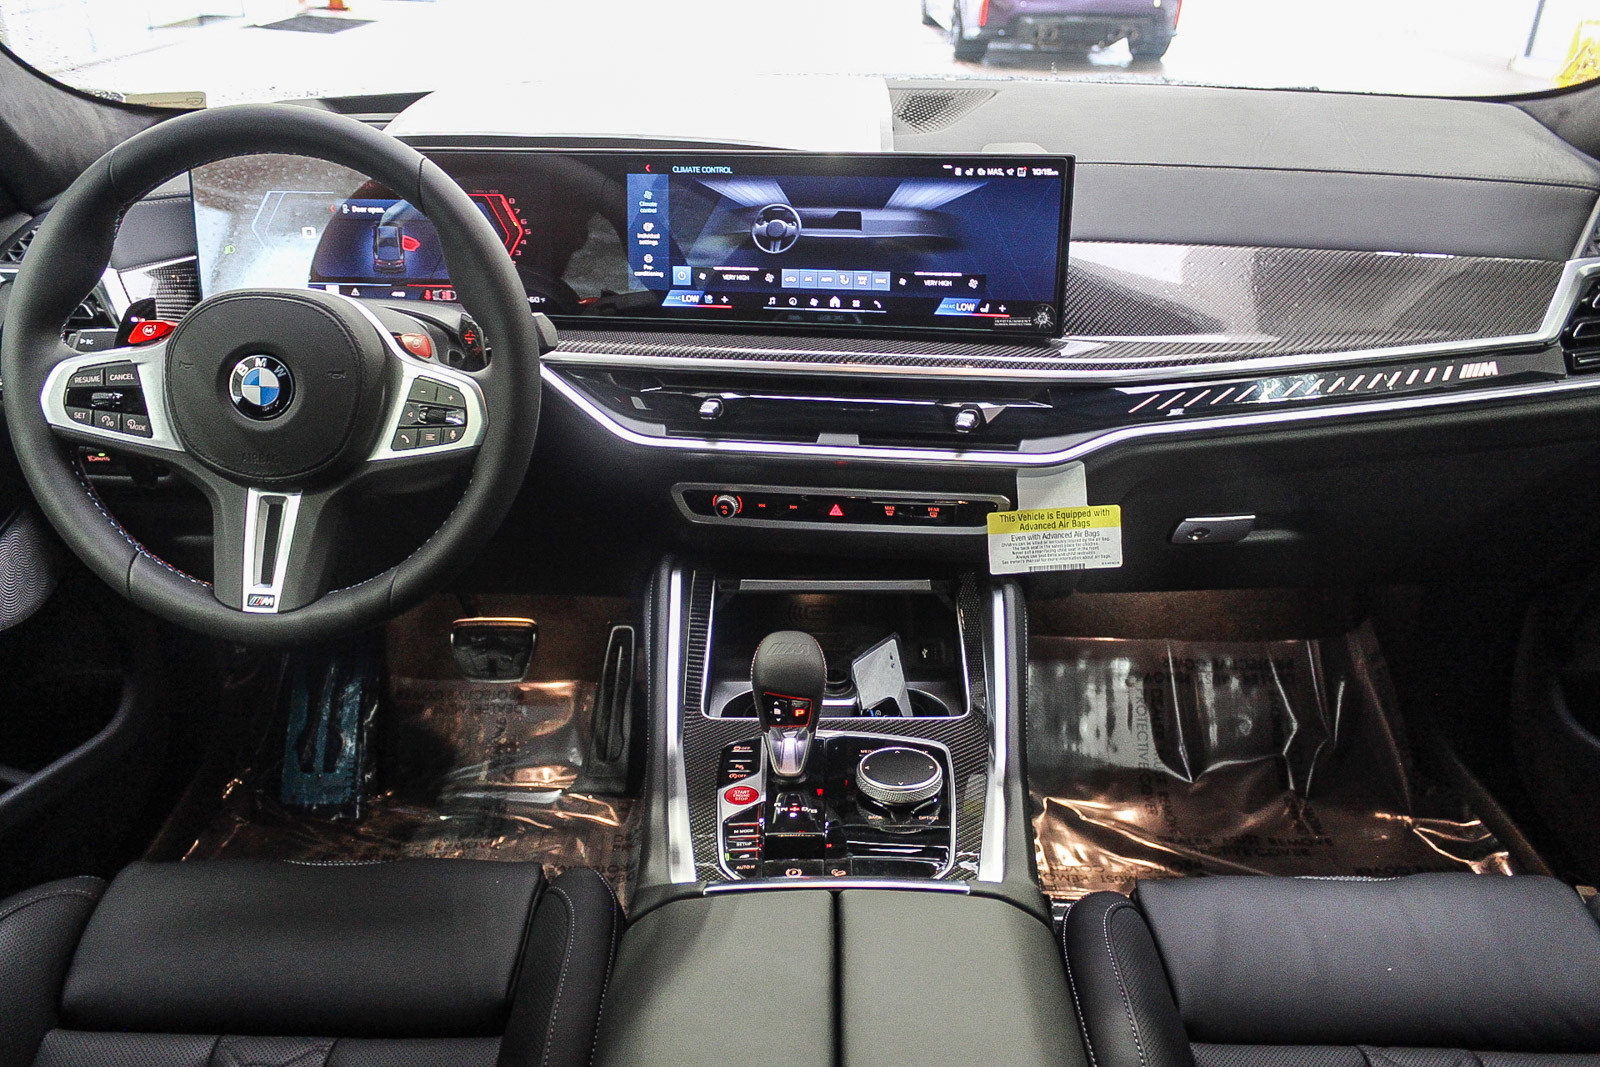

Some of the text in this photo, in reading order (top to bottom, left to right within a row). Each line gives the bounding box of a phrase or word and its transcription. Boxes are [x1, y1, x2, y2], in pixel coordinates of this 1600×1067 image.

[702, 166, 733, 174] CONTROL
[682, 294, 700, 302] LOW
[956, 303, 975, 311] LOW
[236, 358, 286, 378] BMW
[74, 375, 100, 384] RESUME
[1000, 514, 1016, 522] This
[1018, 512, 1044, 521] Vehicle
[1047, 512, 1054, 520] is
[1056, 510, 1091, 520] Equipped
[1020, 520, 1090, 530] Advanced Air Bags
[1084, 530, 1100, 538] Bags
